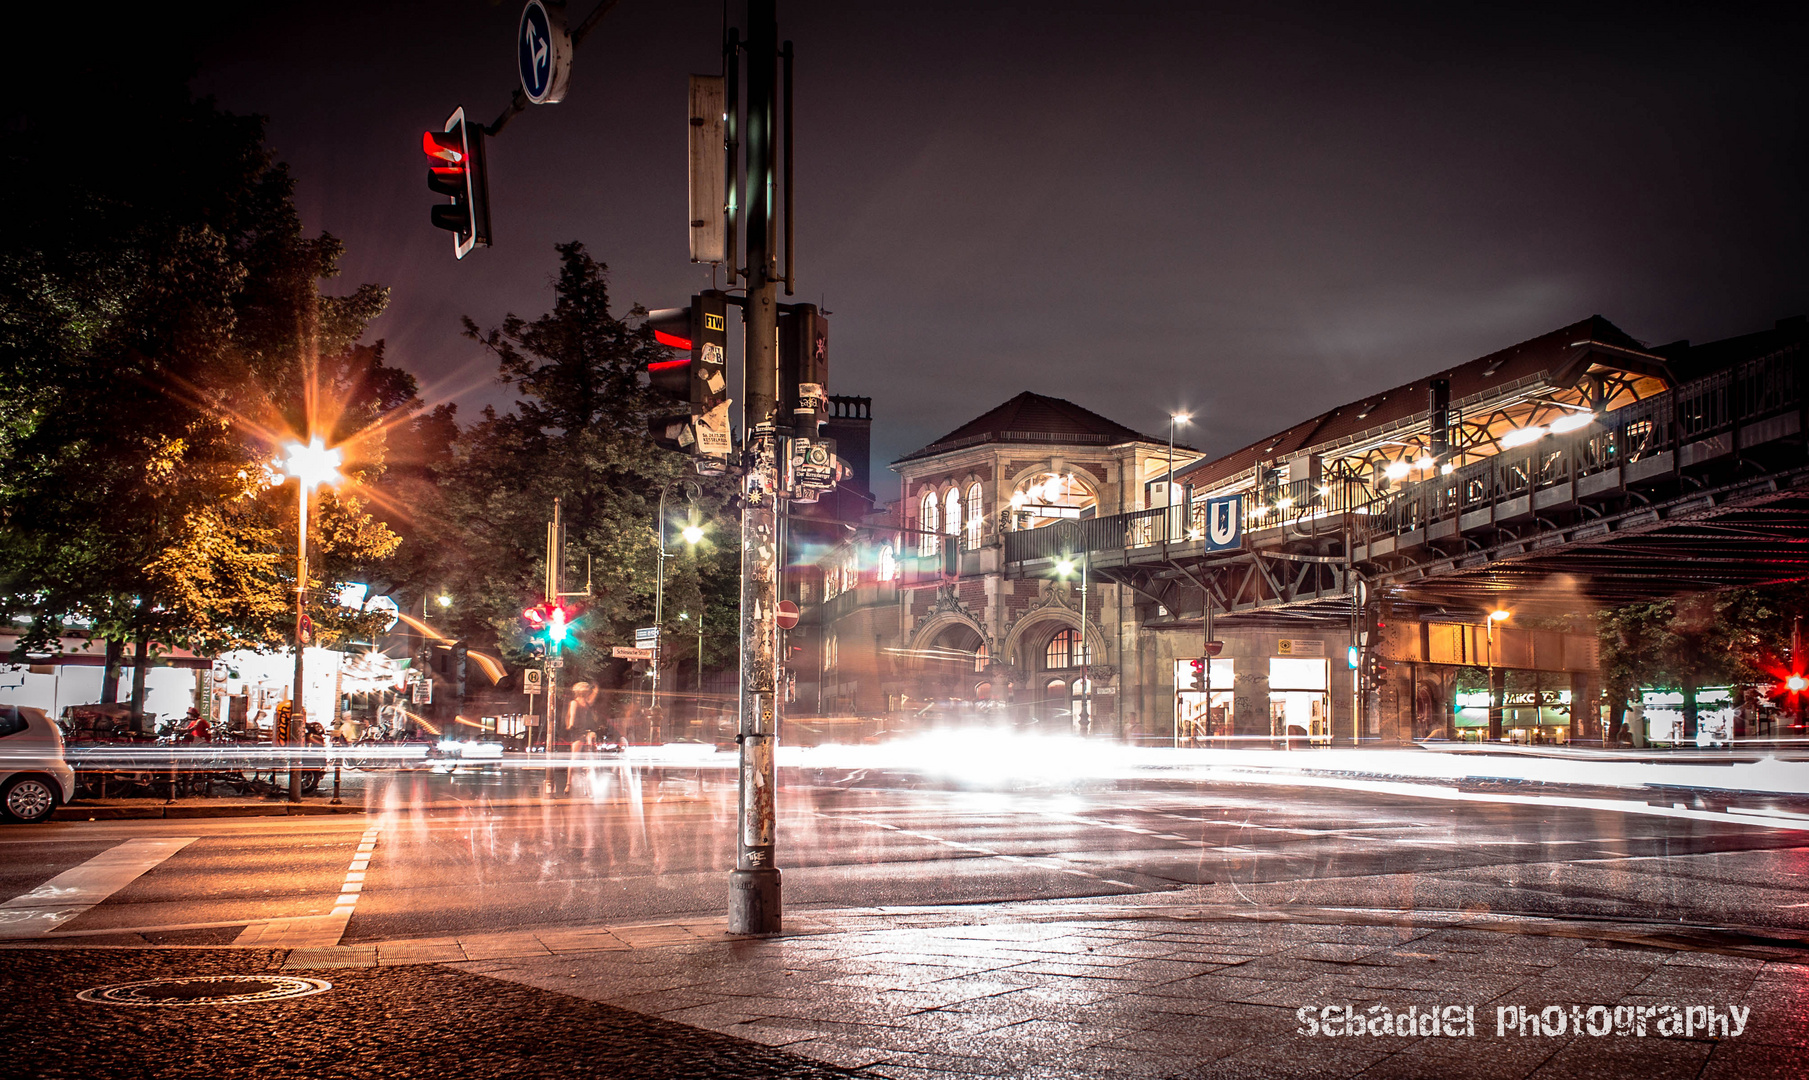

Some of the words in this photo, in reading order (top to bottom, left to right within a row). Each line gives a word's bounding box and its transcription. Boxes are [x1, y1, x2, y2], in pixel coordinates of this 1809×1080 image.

[706, 315, 723, 329] FTW
[1211, 500, 1237, 545] U
[202, 669, 211, 716] ESPRESS
